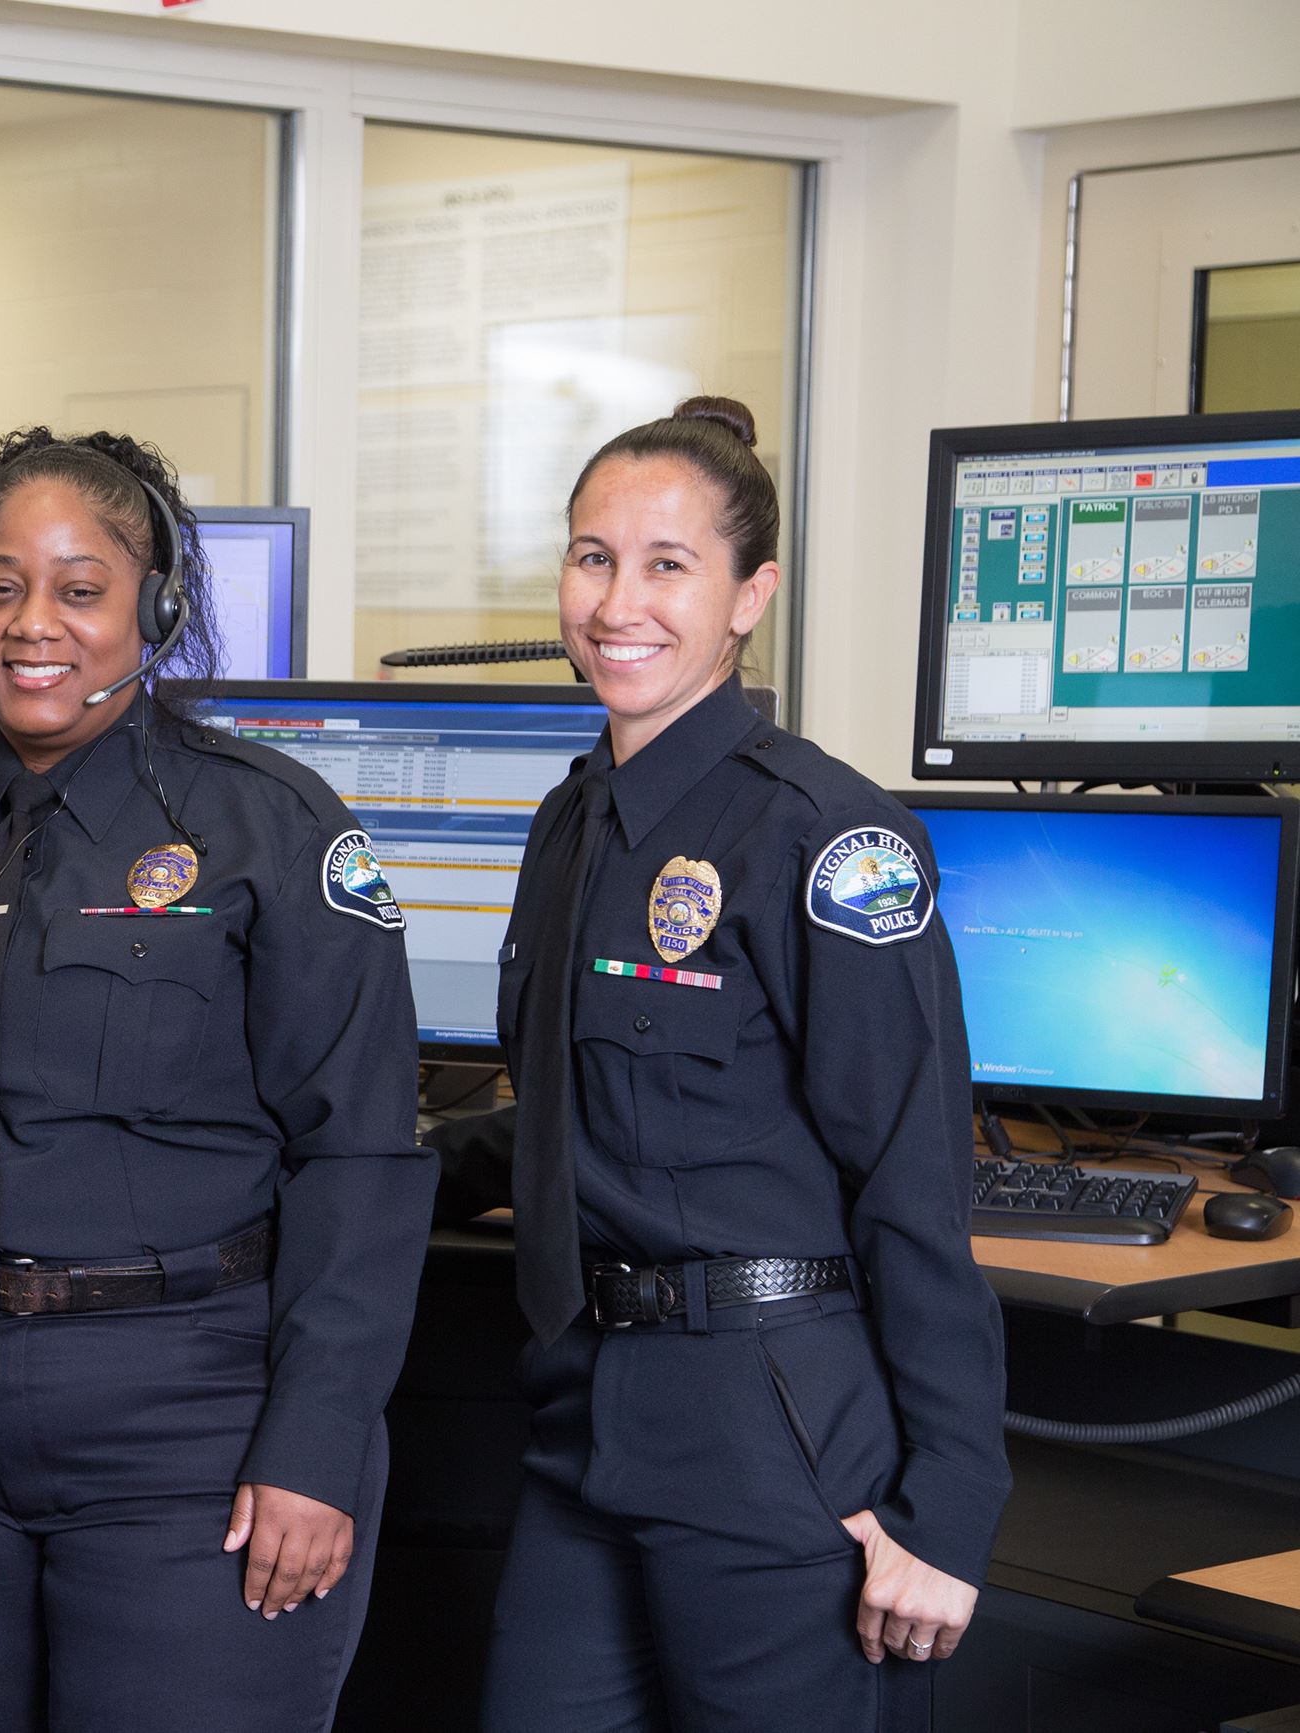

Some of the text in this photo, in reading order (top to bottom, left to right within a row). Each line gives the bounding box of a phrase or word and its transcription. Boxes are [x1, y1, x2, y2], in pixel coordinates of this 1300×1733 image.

[1204, 493, 1257, 504] LB INTEROP
[1079, 503, 1119, 512] PATROL
[1137, 499, 1187, 510] PUBLIC WORKS
[1218, 505, 1233, 514] PD
[1072, 591, 1117, 601] COMMON
[1142, 589, 1164, 599] EOC
[1213, 587, 1247, 597] INTEROP
[1197, 598, 1247, 608] CLEMARS
[330, 836, 363, 884] SIGNAL
[817, 833, 919, 891] SIGNAL HILL
[687, 878, 712, 896] OFFICER
[878, 896, 898, 908] 1924
[657, 918, 699, 935] POLICE
[869, 910, 918, 934] POLICE
[964, 925, 980, 934] Press
[982, 926, 998, 935] CTRL
[1006, 927, 1019, 935] ALT
[1027, 928, 1051, 937] DELETE
[1061, 930, 1072, 938] log
[662, 936, 685, 950] 1150
[983, 1063, 1016, 1073] Windows
